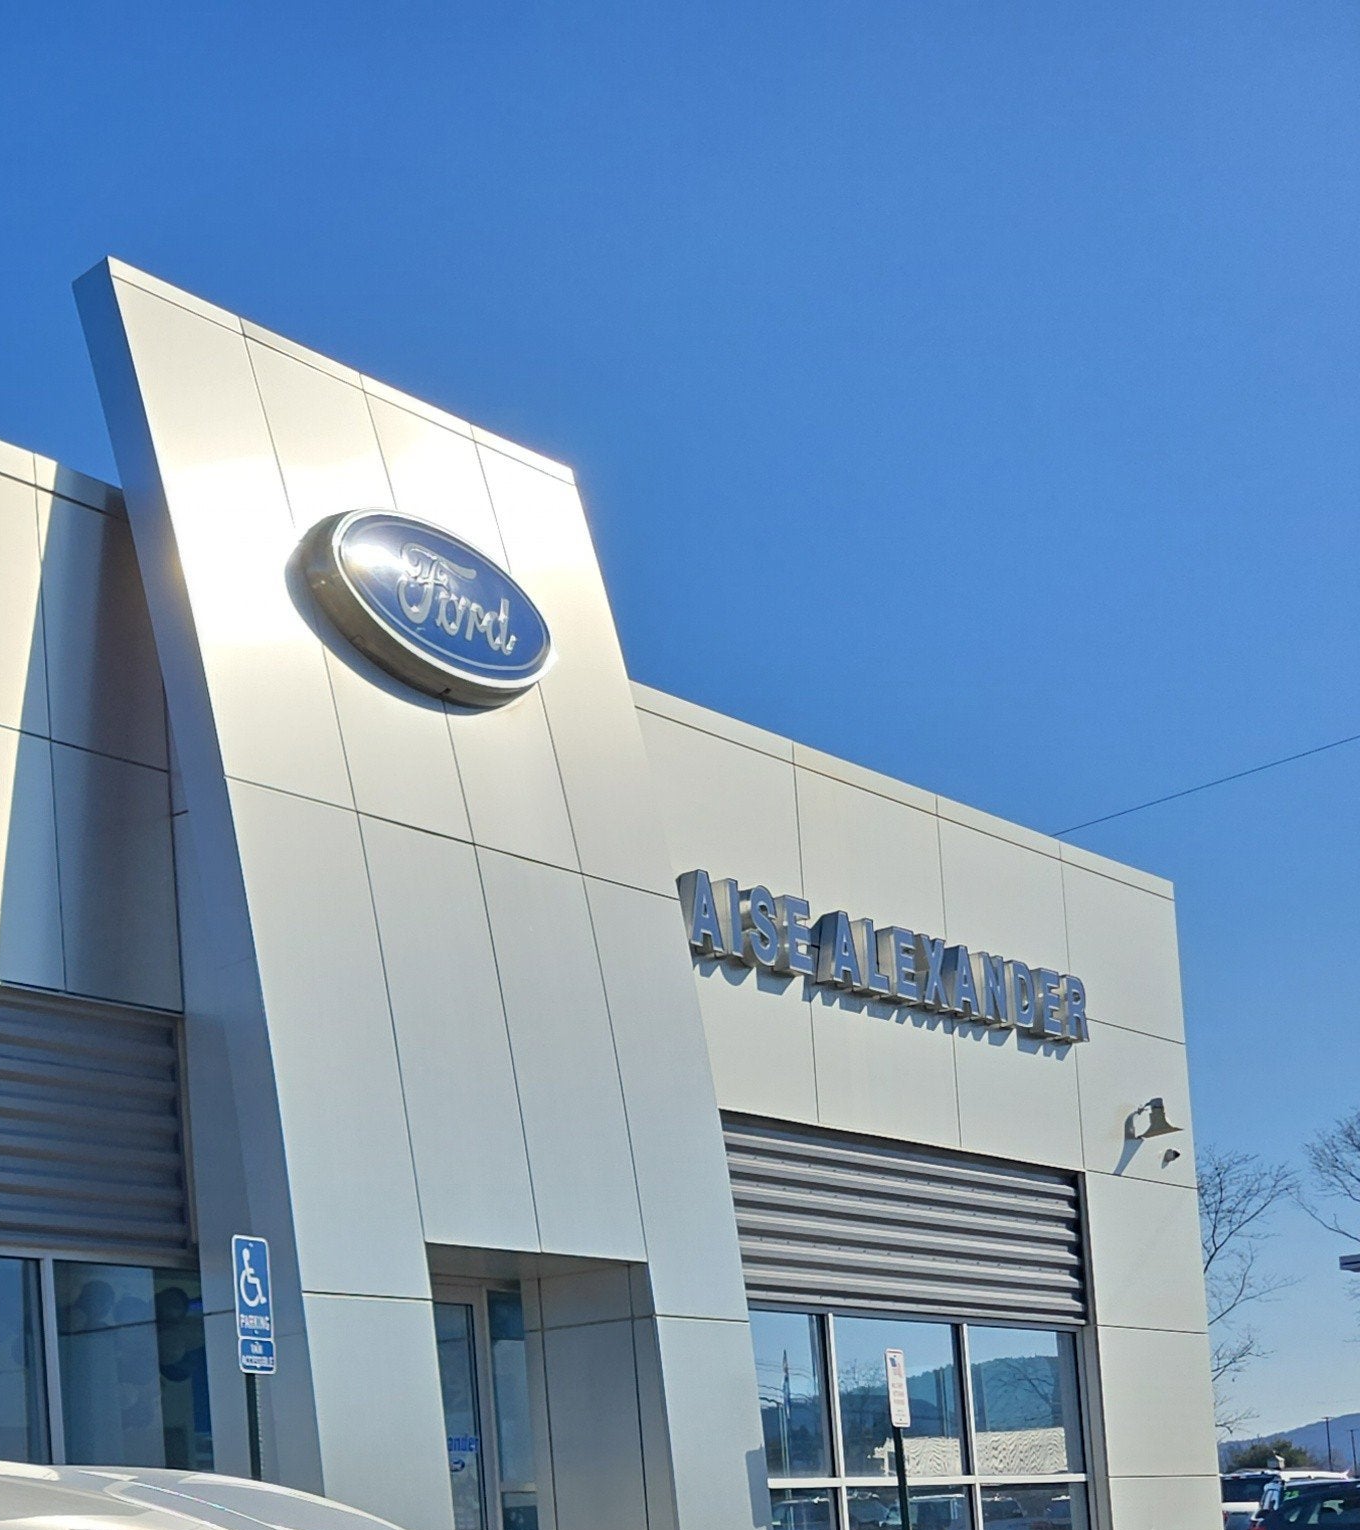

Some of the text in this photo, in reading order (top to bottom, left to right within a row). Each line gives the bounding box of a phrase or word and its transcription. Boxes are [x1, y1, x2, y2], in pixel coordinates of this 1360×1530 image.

[397, 542, 517, 656] Ford
[680, 869, 1091, 1043] AISE ALEXANDER
